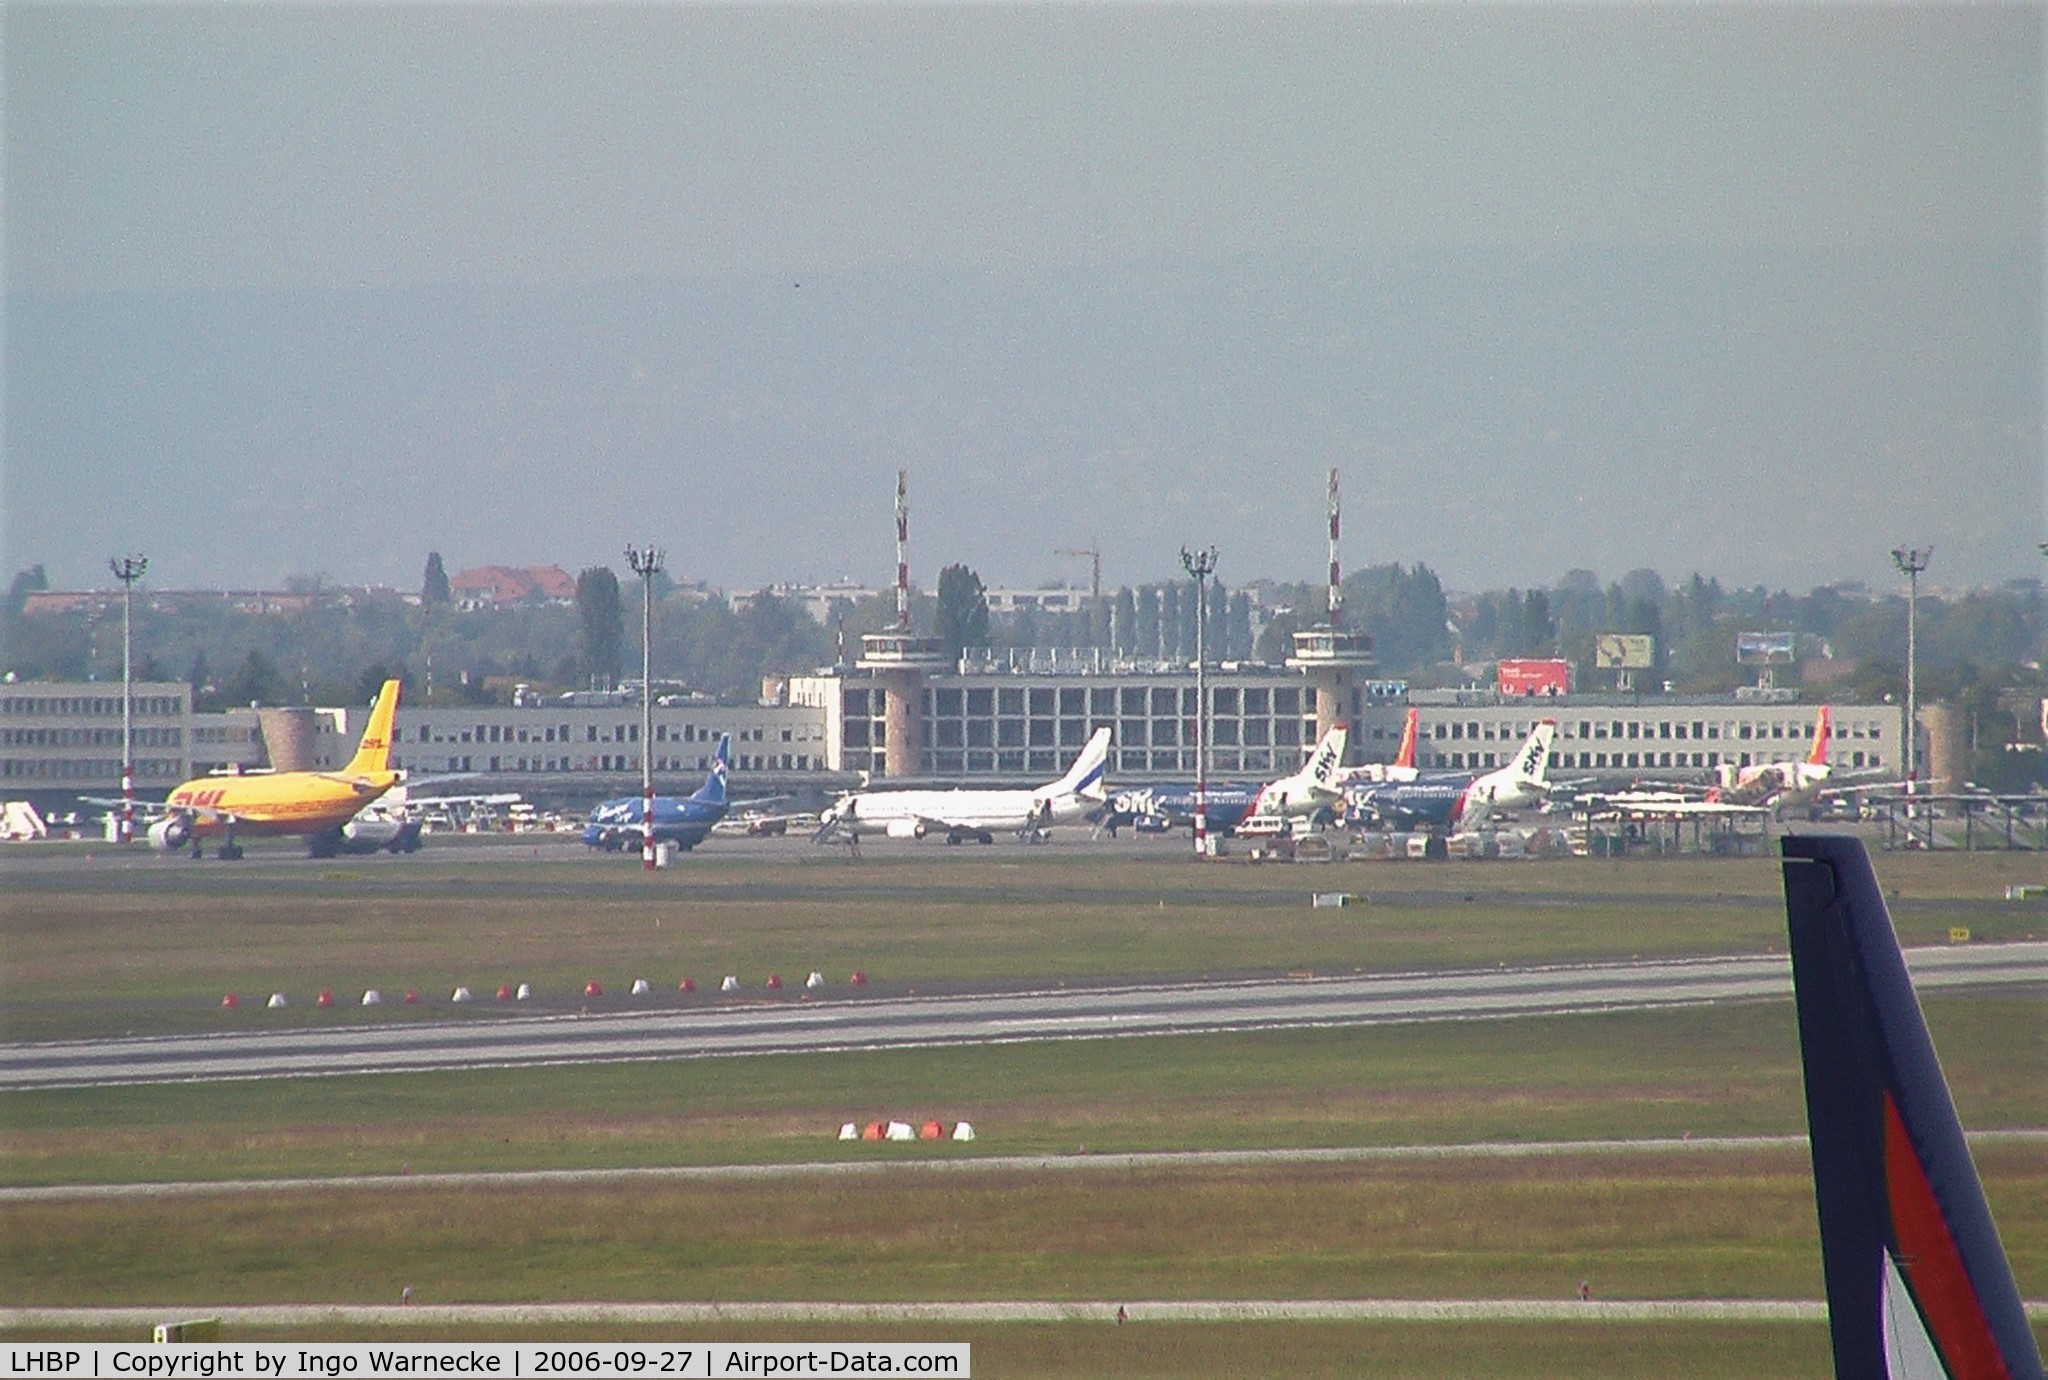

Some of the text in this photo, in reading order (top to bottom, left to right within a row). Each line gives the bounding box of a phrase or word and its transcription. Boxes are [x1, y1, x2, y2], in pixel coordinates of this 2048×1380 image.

[1314, 741, 1337, 783] SKY
[1523, 735, 1545, 777] SKY
[173, 789, 227, 807] DHL
